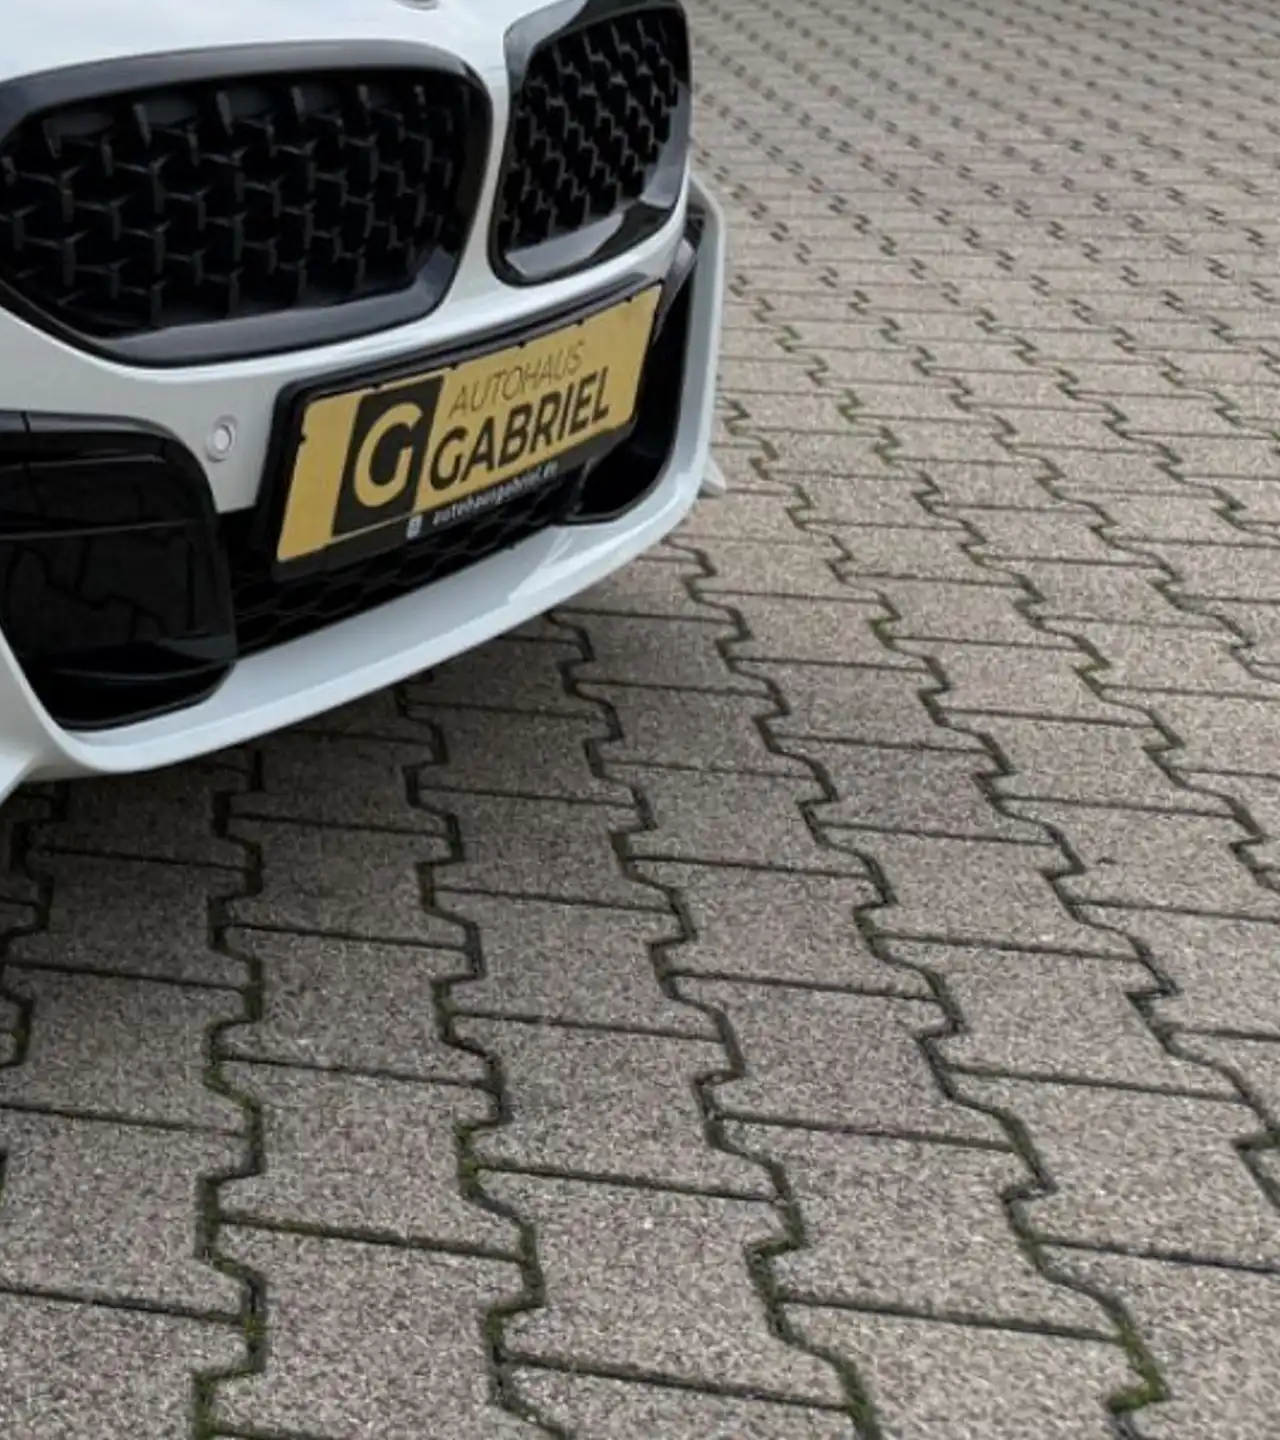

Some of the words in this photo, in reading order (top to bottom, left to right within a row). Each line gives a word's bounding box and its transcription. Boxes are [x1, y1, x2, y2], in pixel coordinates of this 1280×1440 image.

[430, 366, 609, 490] GABRIEL
[448, 340, 585, 418] AUTOHAUS
[354, 402, 423, 507] G
